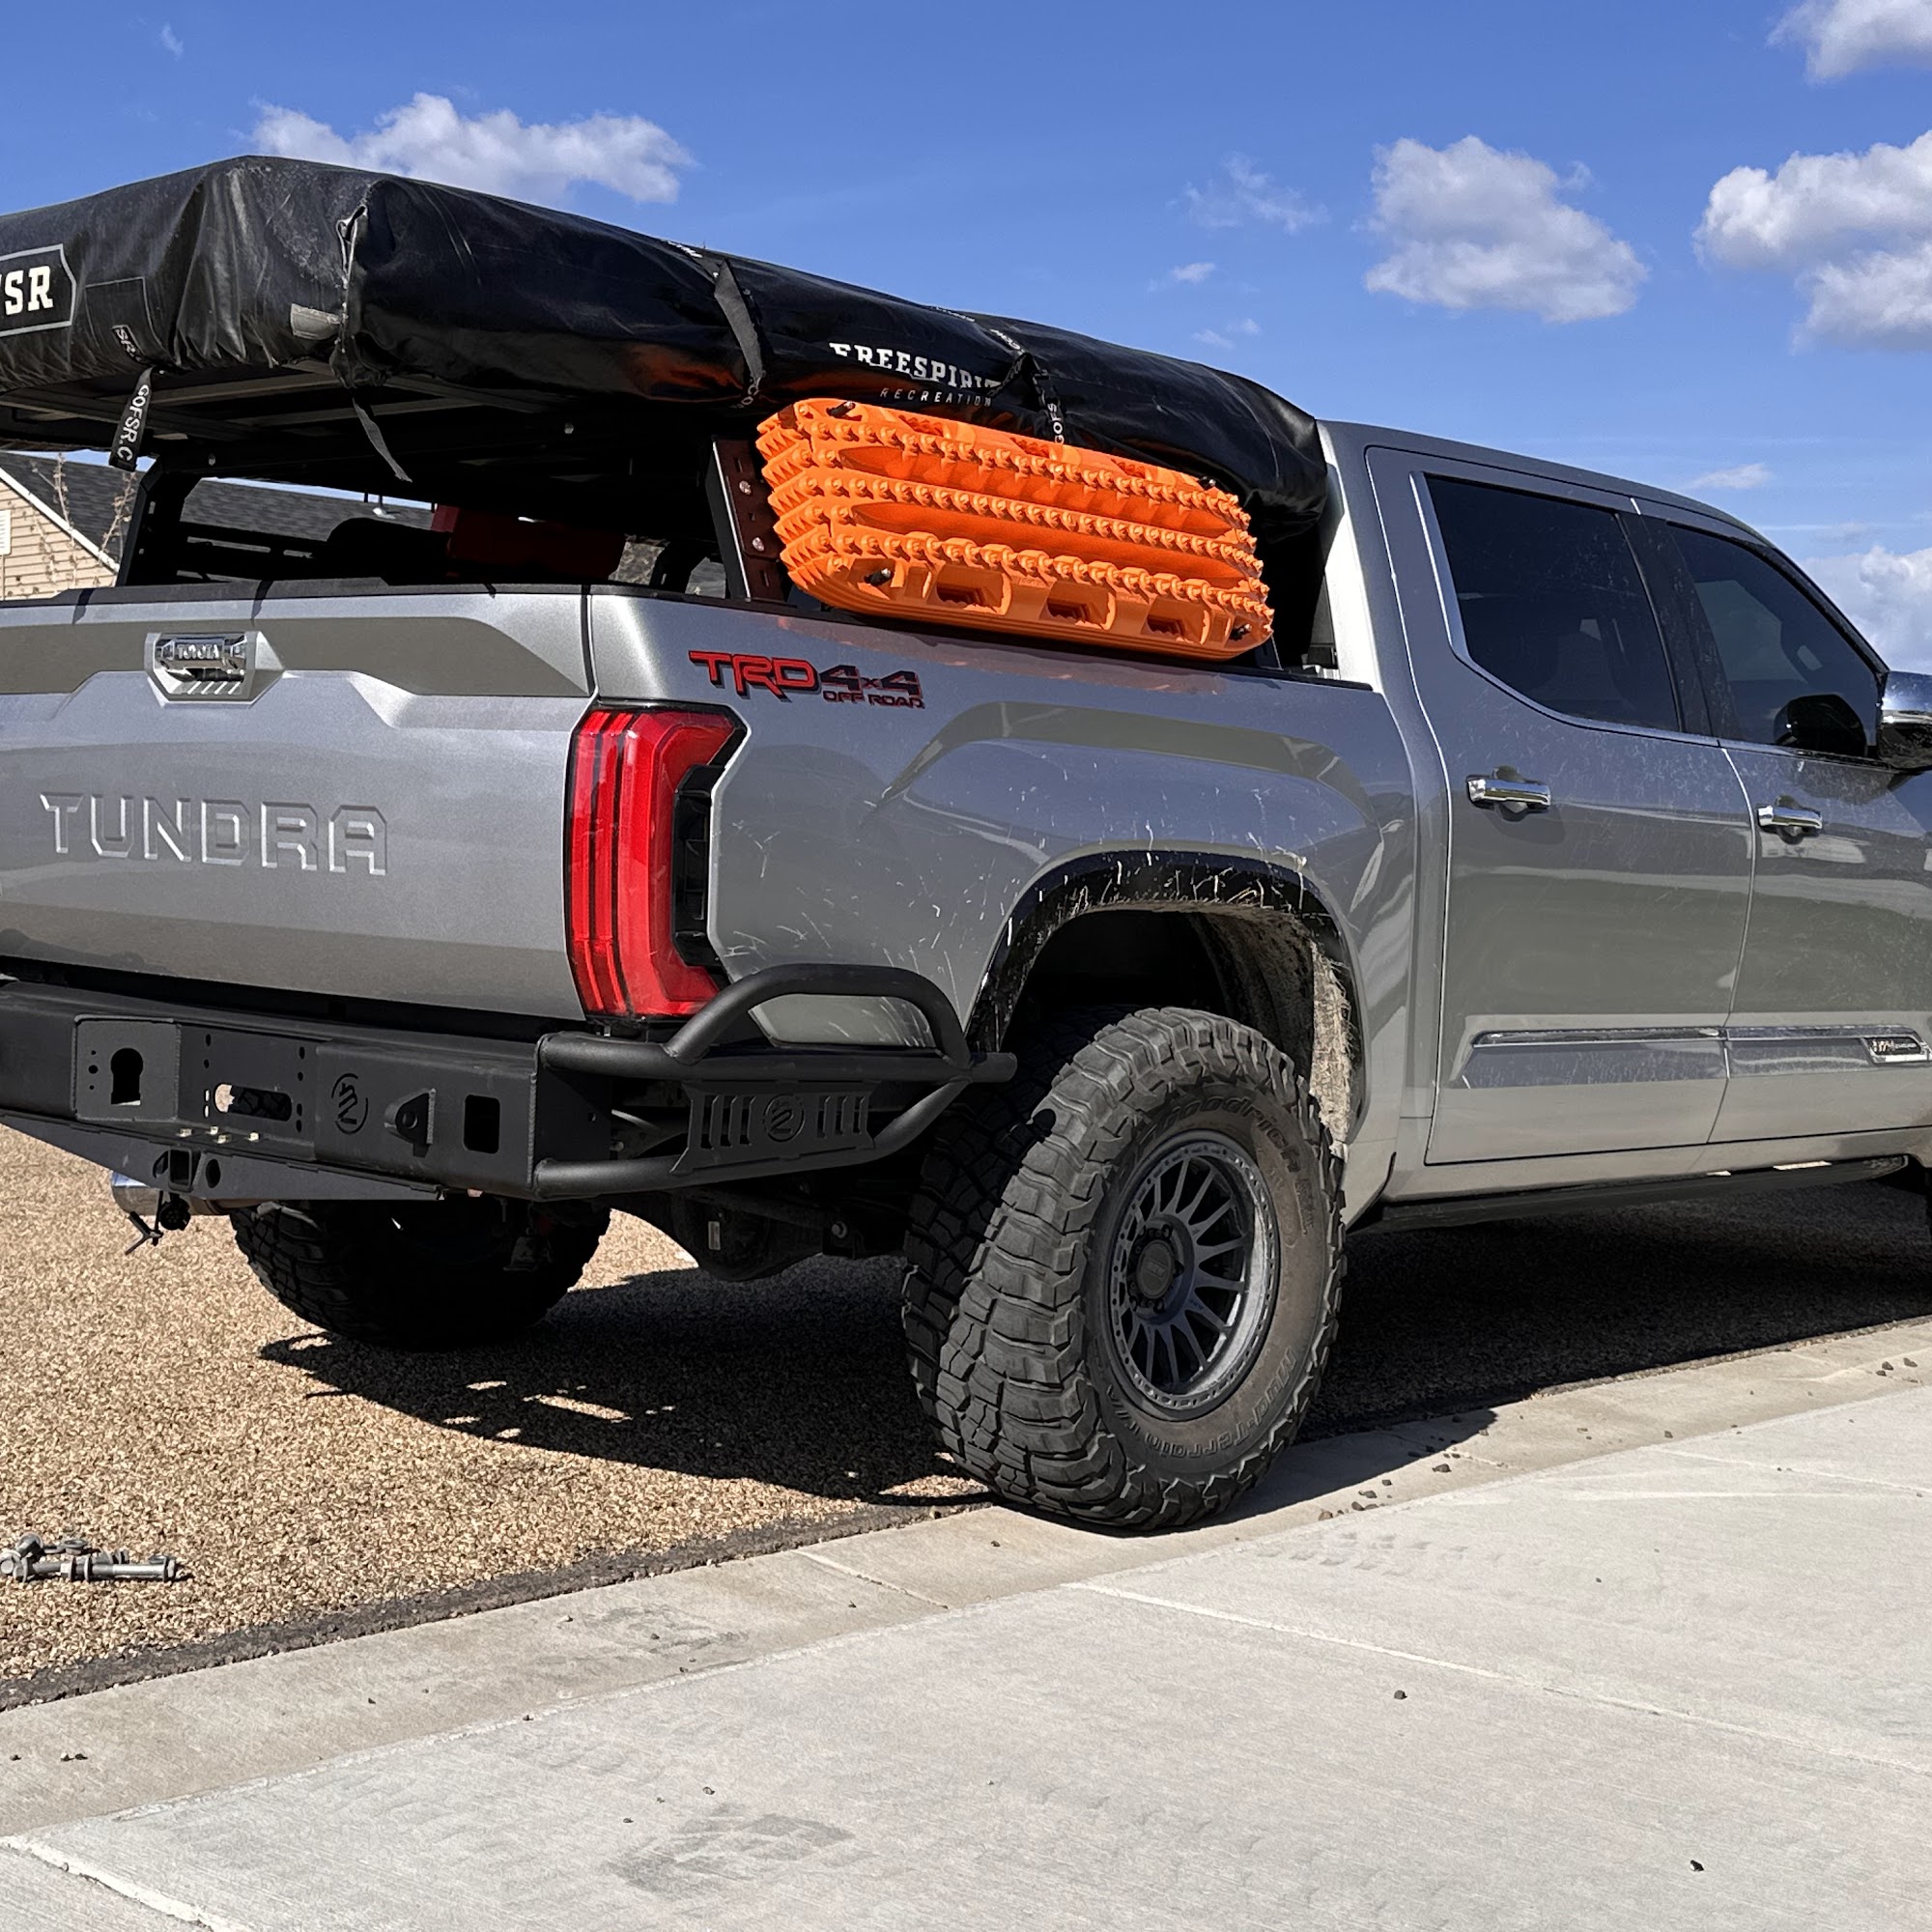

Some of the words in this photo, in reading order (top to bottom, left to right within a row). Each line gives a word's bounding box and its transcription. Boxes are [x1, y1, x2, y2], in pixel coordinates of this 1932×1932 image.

[0, 265, 54, 316] SR
[880, 387, 992, 407] RECREATION
[688, 651, 820, 702] TRD
[822, 690, 865, 703] OFF
[867, 694, 925, 709] ROAD
[40, 791, 387, 875] TUNDRA
